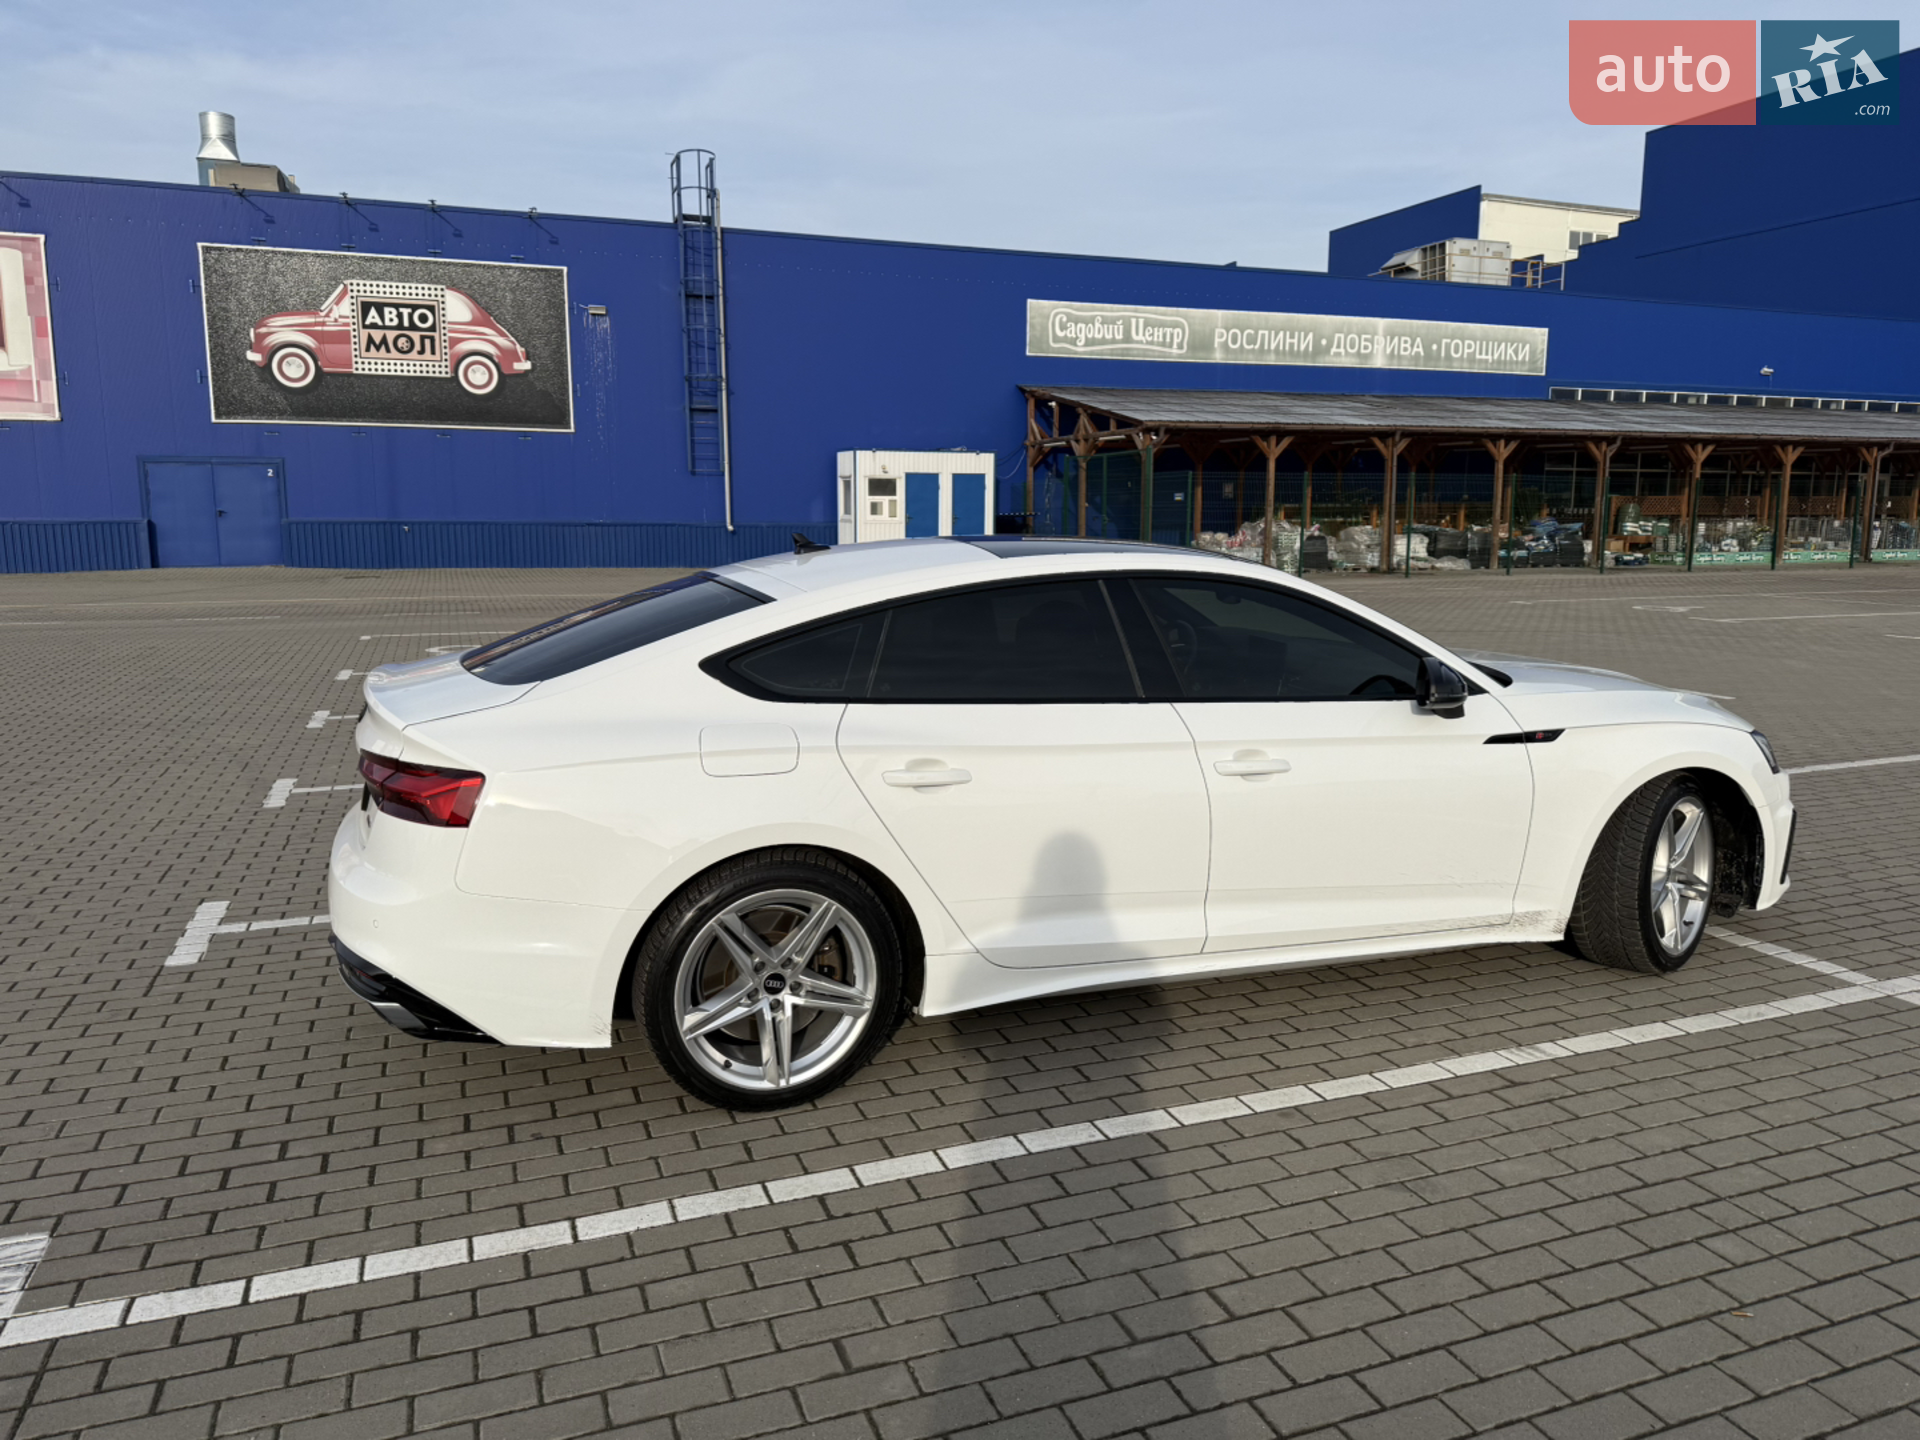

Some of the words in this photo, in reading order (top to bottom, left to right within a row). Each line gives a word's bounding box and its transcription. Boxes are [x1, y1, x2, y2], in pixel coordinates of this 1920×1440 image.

[364, 305, 434, 329] АВТО
[364, 331, 437, 356] МОЛ
[1055, 313, 1124, 346] Садовий
[1130, 317, 1183, 350] Центр
[1214, 328, 1314, 352] РОСЛИНИ
[1330, 333, 1425, 356] ДОБРИВА
[1440, 338, 1530, 363] ГОРЩИКИ
[267, 468, 274, 477] 2
